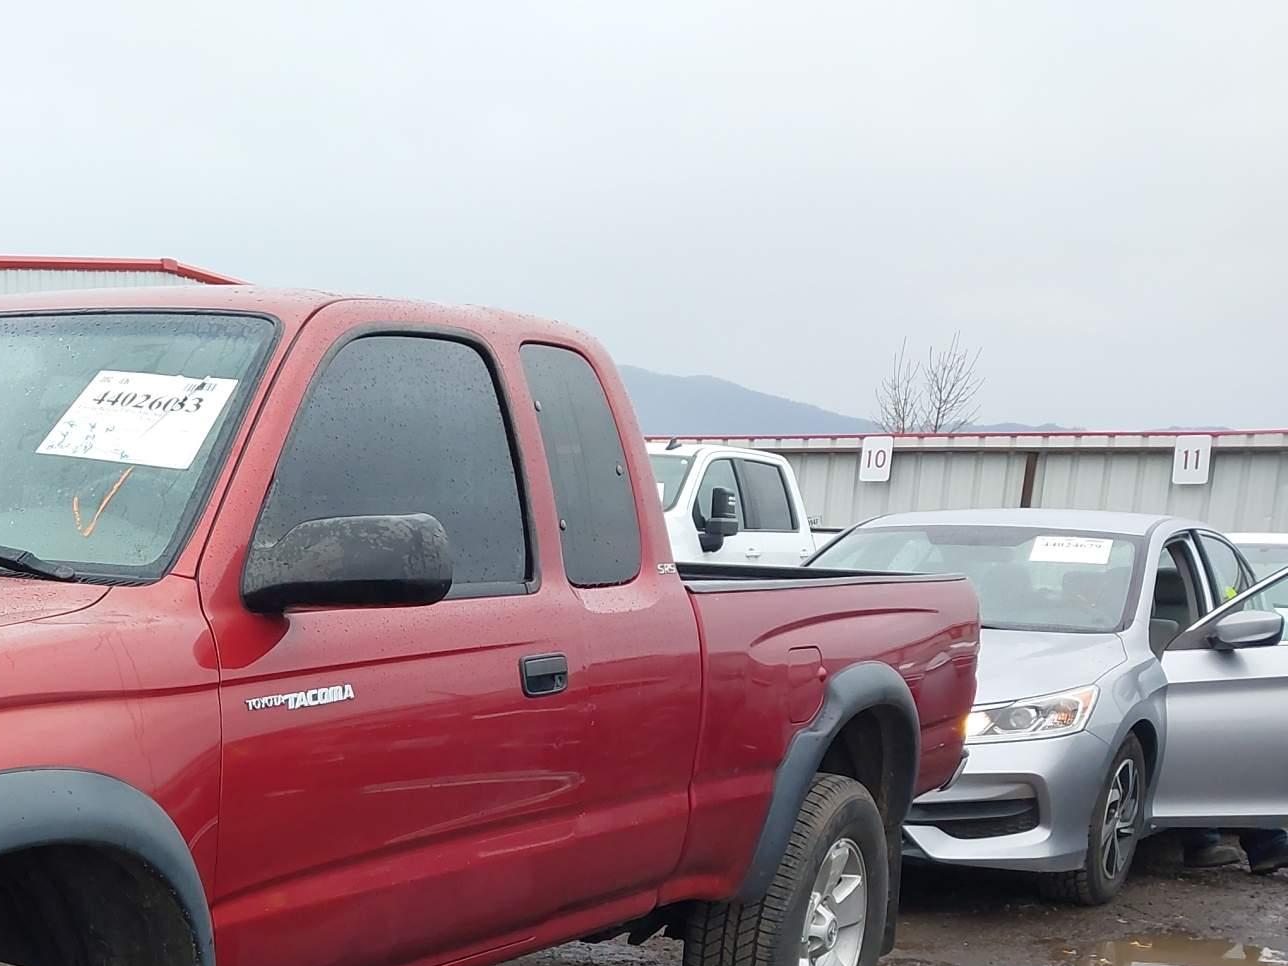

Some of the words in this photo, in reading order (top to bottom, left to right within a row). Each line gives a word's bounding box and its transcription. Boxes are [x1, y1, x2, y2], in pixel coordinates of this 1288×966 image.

[93, 390, 204, 413] 44026033
[865, 448, 887, 470] 10
[1182, 448, 1201, 471] 11
[246, 694, 285, 711] TOYOTA
[284, 684, 355, 710] TACOMA
